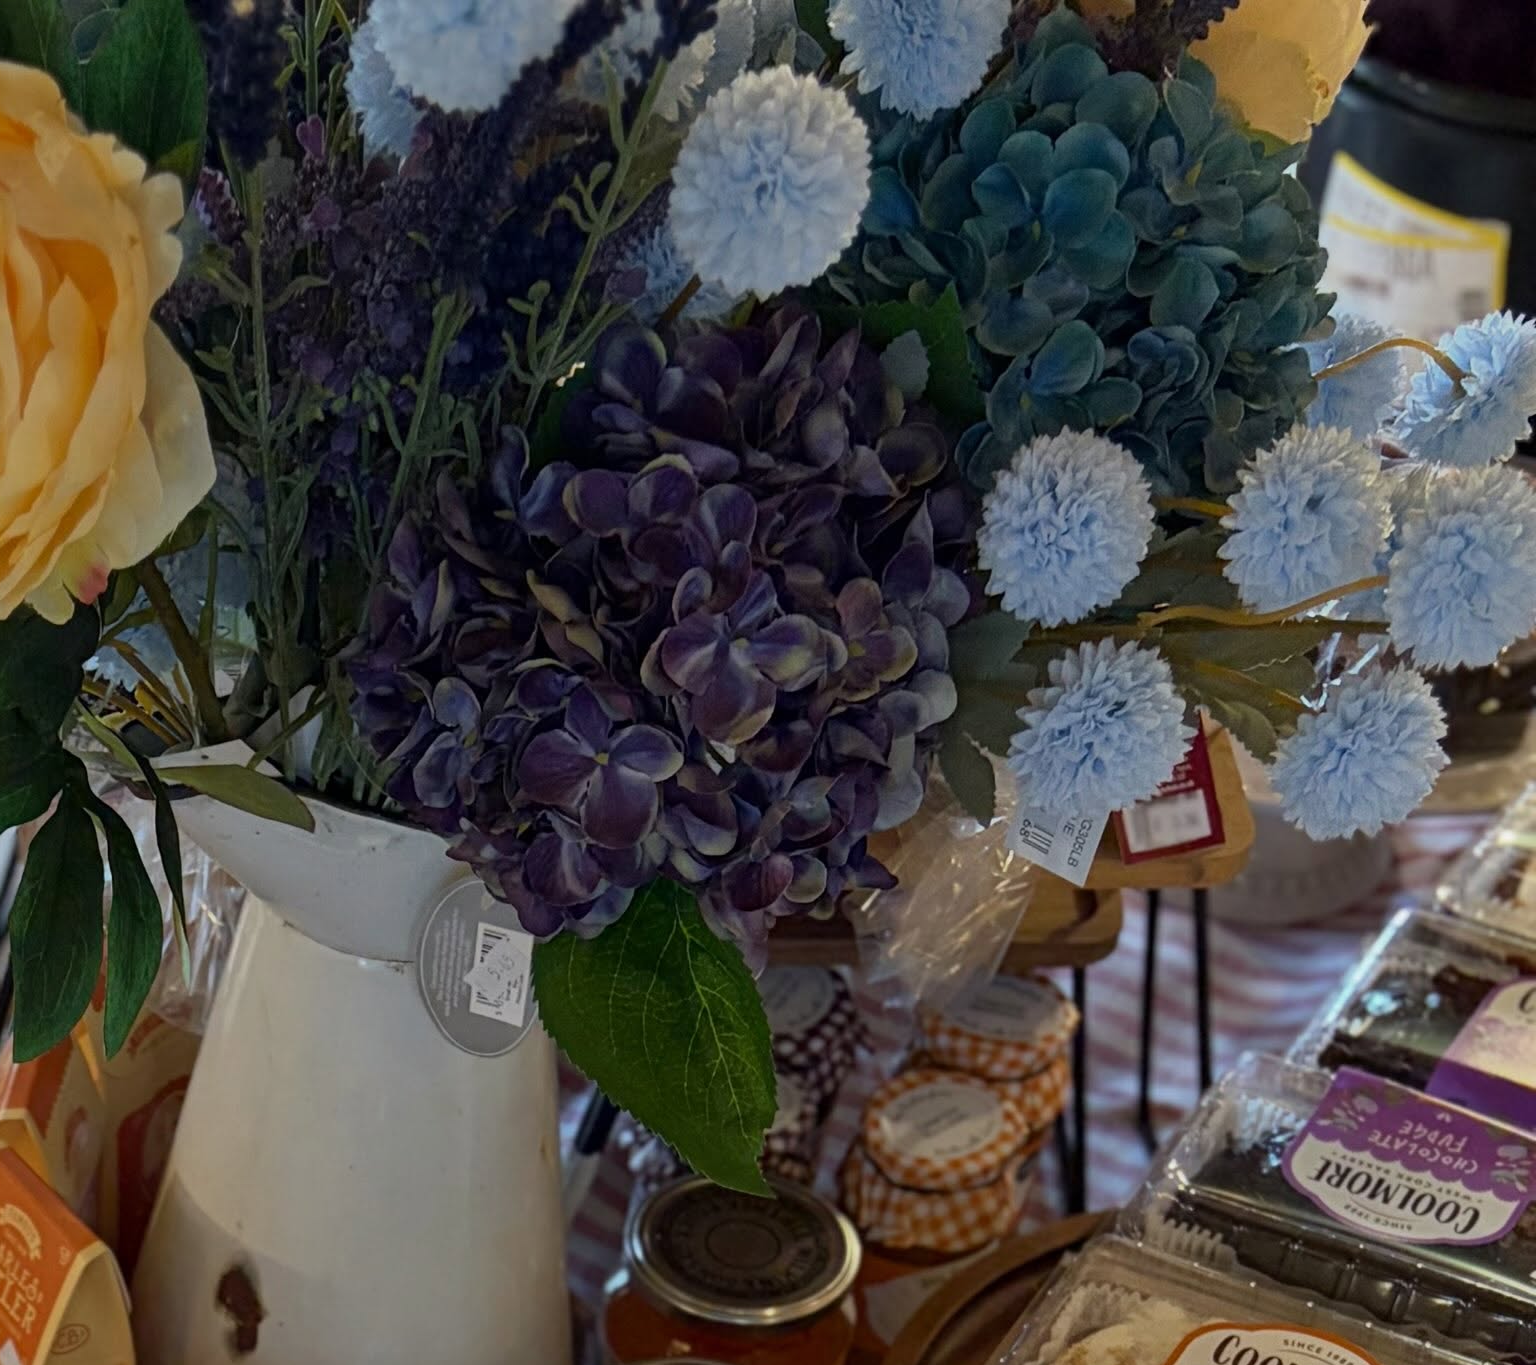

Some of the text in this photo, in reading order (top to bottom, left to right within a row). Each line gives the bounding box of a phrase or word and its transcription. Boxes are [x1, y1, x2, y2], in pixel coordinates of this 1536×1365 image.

[1368, 1130, 1478, 1174] CHOCOLATE
[1399, 1121, 1468, 1153] FUDGE
[1340, 1154, 1432, 1188] CORK BAKERY
[1308, 1156, 1480, 1234] COOLMORE
[1283, 1338, 1322, 1354] SINCE
